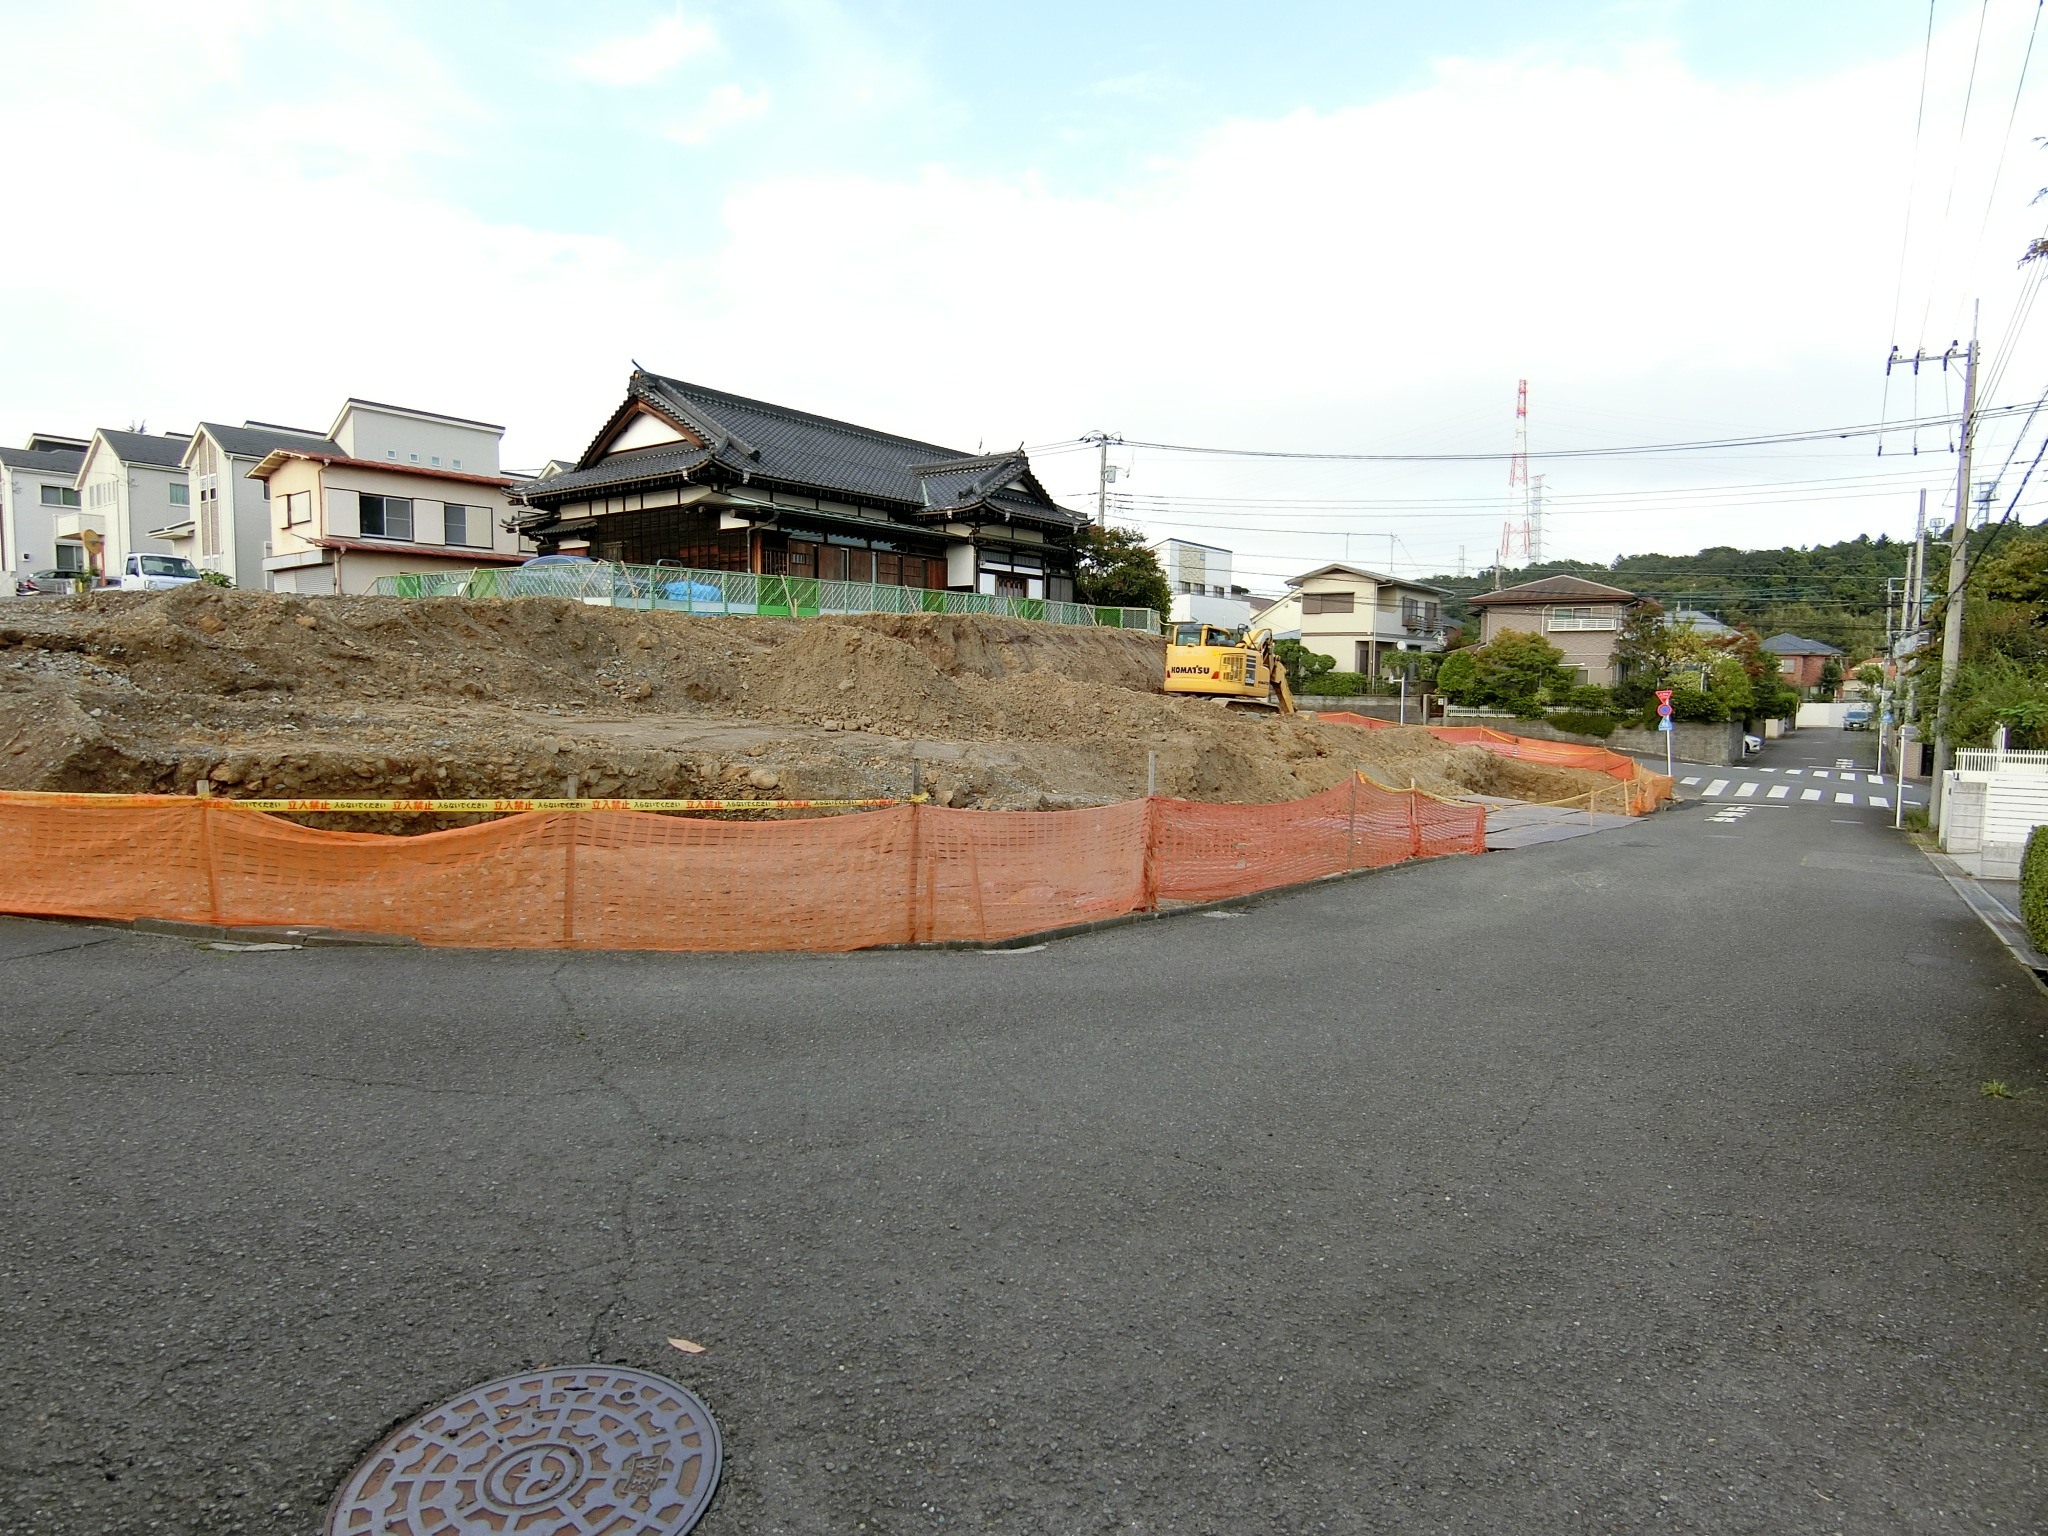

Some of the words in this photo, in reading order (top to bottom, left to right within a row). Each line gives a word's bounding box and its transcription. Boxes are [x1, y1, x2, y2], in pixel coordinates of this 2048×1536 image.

[1171, 665, 1210, 675] KOMATSU
[287, 800, 331, 810] 立入禁止
[392, 800, 434, 811] 立入禁止
[437, 801, 488, 809] 入らないでください
[493, 800, 534, 811] 立入禁止
[591, 800, 631, 810] 立入禁止
[686, 800, 723, 809] 立入禁止
